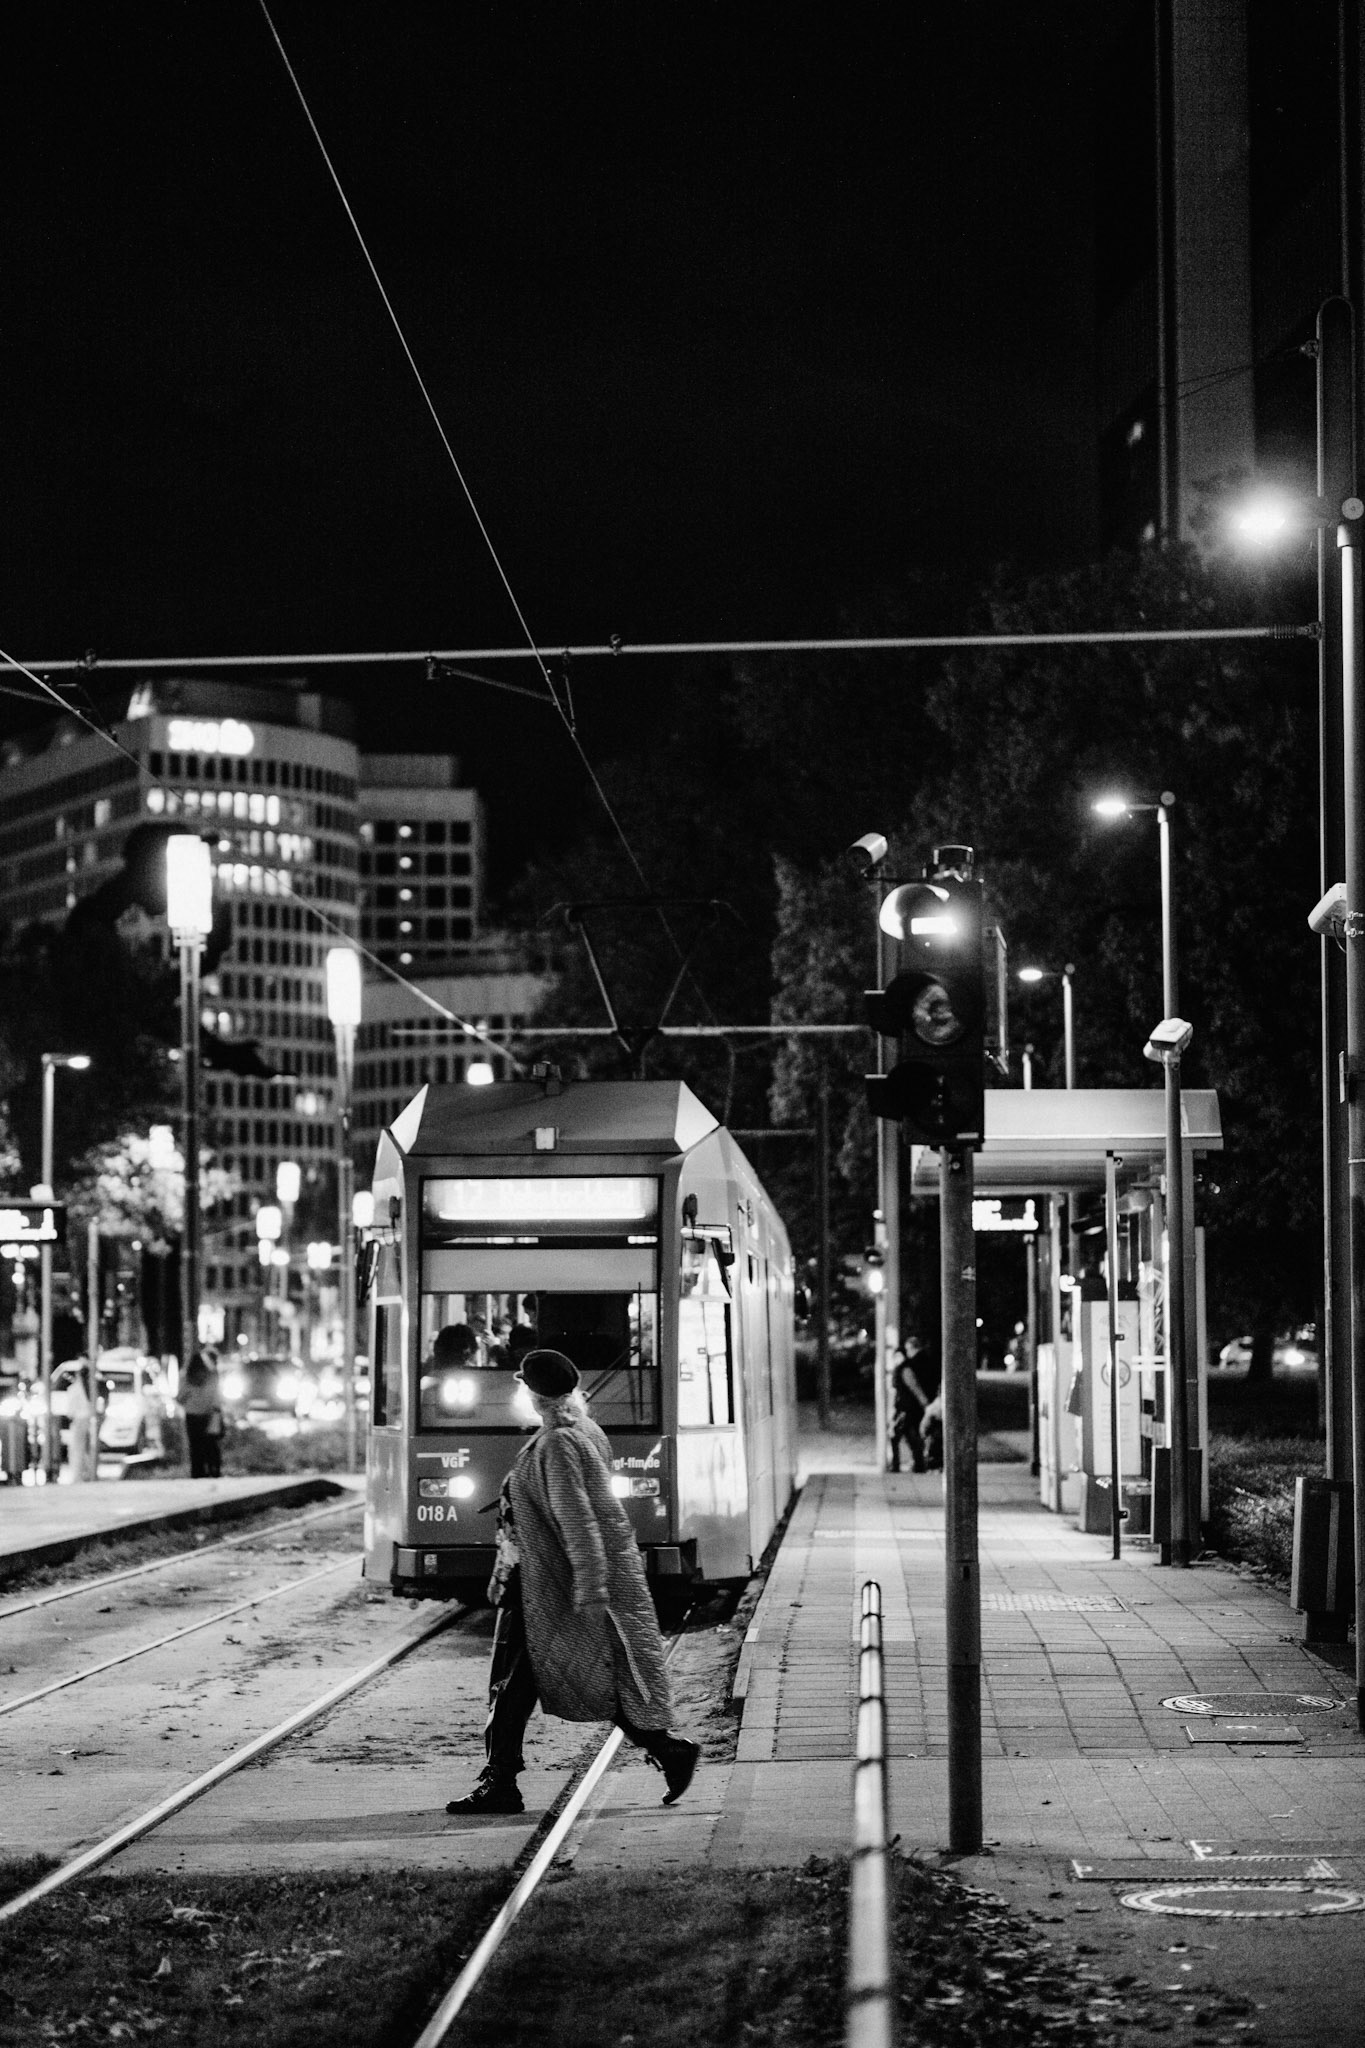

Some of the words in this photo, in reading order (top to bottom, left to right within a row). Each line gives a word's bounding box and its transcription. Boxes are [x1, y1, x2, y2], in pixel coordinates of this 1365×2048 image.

[441, 1448, 470, 1468] VGF
[417, 1505, 444, 1522] 018
[446, 1505, 458, 1522] A
